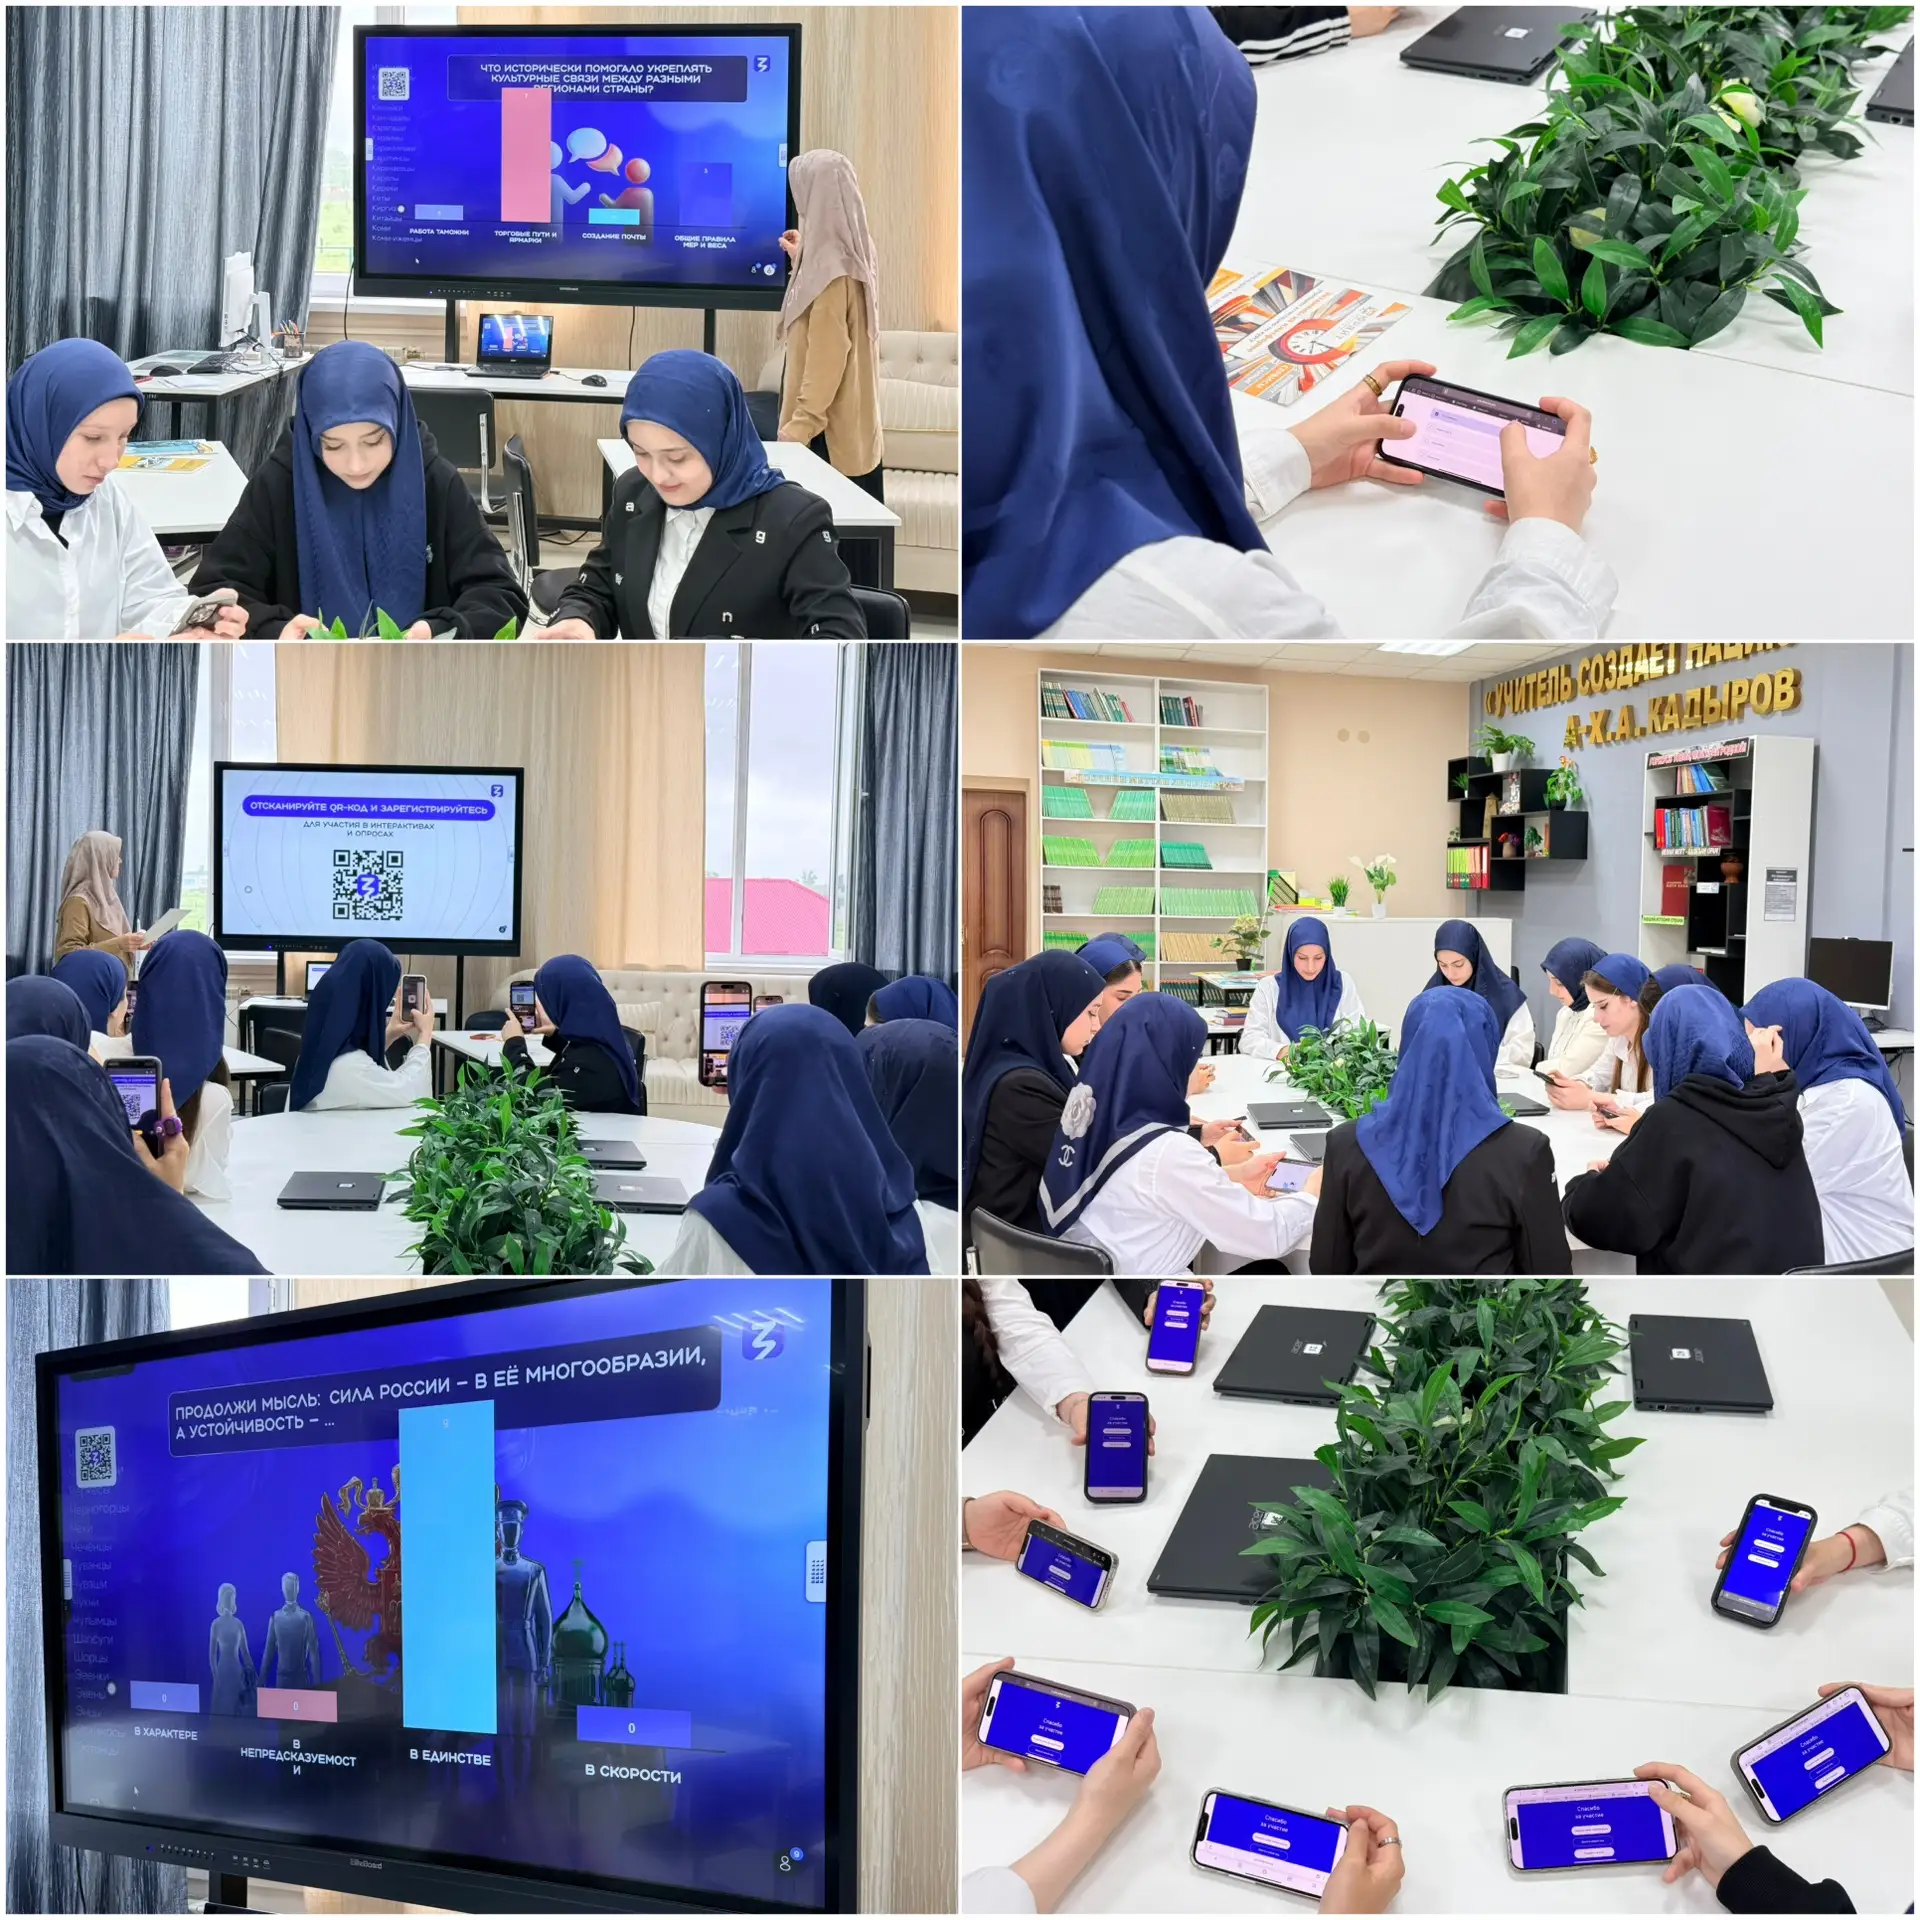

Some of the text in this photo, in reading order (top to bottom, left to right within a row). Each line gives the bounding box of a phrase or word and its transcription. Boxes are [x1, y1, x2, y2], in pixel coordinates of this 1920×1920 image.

[480, 64, 712, 74] ЧТО ИСТОРИЧЕСКИ ПОМОГАЛО УКРЕПЛЯТЬ
[491, 74, 701, 84] КУЛЬТУРНЫЕ СВЯЗИ МЕЖДУ РАЗНЫМИ
[602, 84, 654, 94] СТРАНЫ?
[372, 204, 398, 213] Киргиз
[494, 230, 530, 238] ТОРГОВЫЕ
[582, 232, 620, 240] СОЗДАНИЕ
[674, 235, 700, 243] ОБЩИЕ
[250, 802, 327, 812] ОТСКАНИРУЙТЕ
[329, 803, 368, 813] QR-КОД
[380, 804, 488, 815] ЗАРЕГИСТРИРУЙТЕСЬ
[303, 820, 320, 828] ДЛЯ
[323, 821, 361, 829] УЧАСТИЯ
[371, 822, 435, 830] ИНТЕРАКТИВАХ
[355, 830, 394, 838] ОПРОСАХ
[176, 1399, 256, 1420] ПРОДОЛЖИ
[262, 1392, 321, 1412] МЫСЛЬ:
[329, 1386, 374, 1404] СИЛА
[380, 1376, 450, 1400] РОССИИ
[475, 1372, 488, 1390] В
[494, 1366, 519, 1388] ЕЁ
[526, 1344, 706, 1384] МНОГООБРАЗИИ,
[176, 1430, 186, 1440] А
[190, 1416, 304, 1438] УСТОЙЧИВОСТЬ
[293, 1702, 299, 1712] 0
[628, 1722, 636, 1734] 0
[134, 1726, 198, 1741] В ХАРАКТЕРЕ
[293, 1740, 300, 1749] В
[240, 1747, 356, 1768] НЕПРЕДСКАЗУЕМОСТ
[409, 1748, 491, 1766] В ЕДИНСТВЕ
[293, 1765, 300, 1776] И
[584, 1764, 682, 1784] В СКОРОСТИ
[1264, 1814, 1288, 1825] Спасибо
